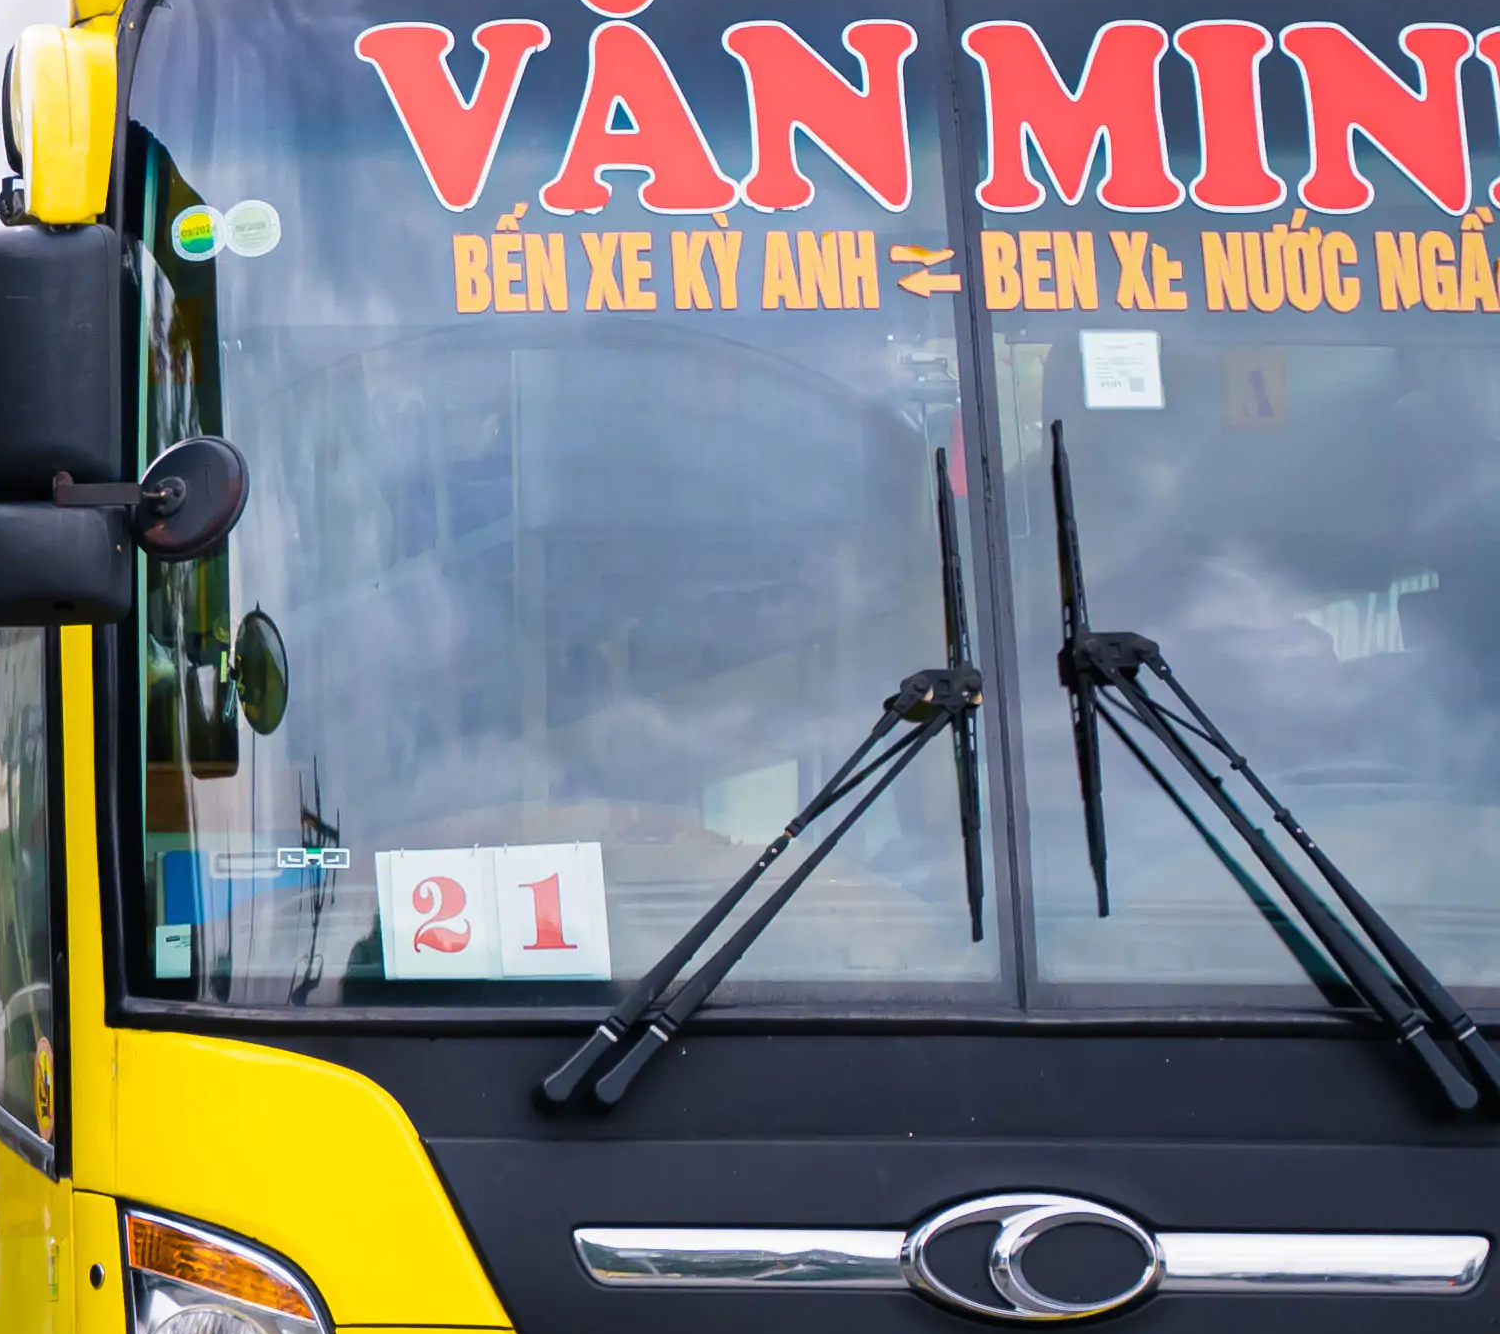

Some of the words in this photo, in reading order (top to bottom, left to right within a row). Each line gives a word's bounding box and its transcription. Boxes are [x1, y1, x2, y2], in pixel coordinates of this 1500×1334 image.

[961, 19, 1500, 216] MIN
[452, 202, 568, 313] BẾN
[580, 231, 657, 310] XE
[670, 212, 743, 310] KỲ
[761, 229, 880, 310] ANH
[1200, 208, 1361, 313] NƯỚC
[1374, 206, 1500, 312] NGẦ
[412, 872, 578, 954] 21
